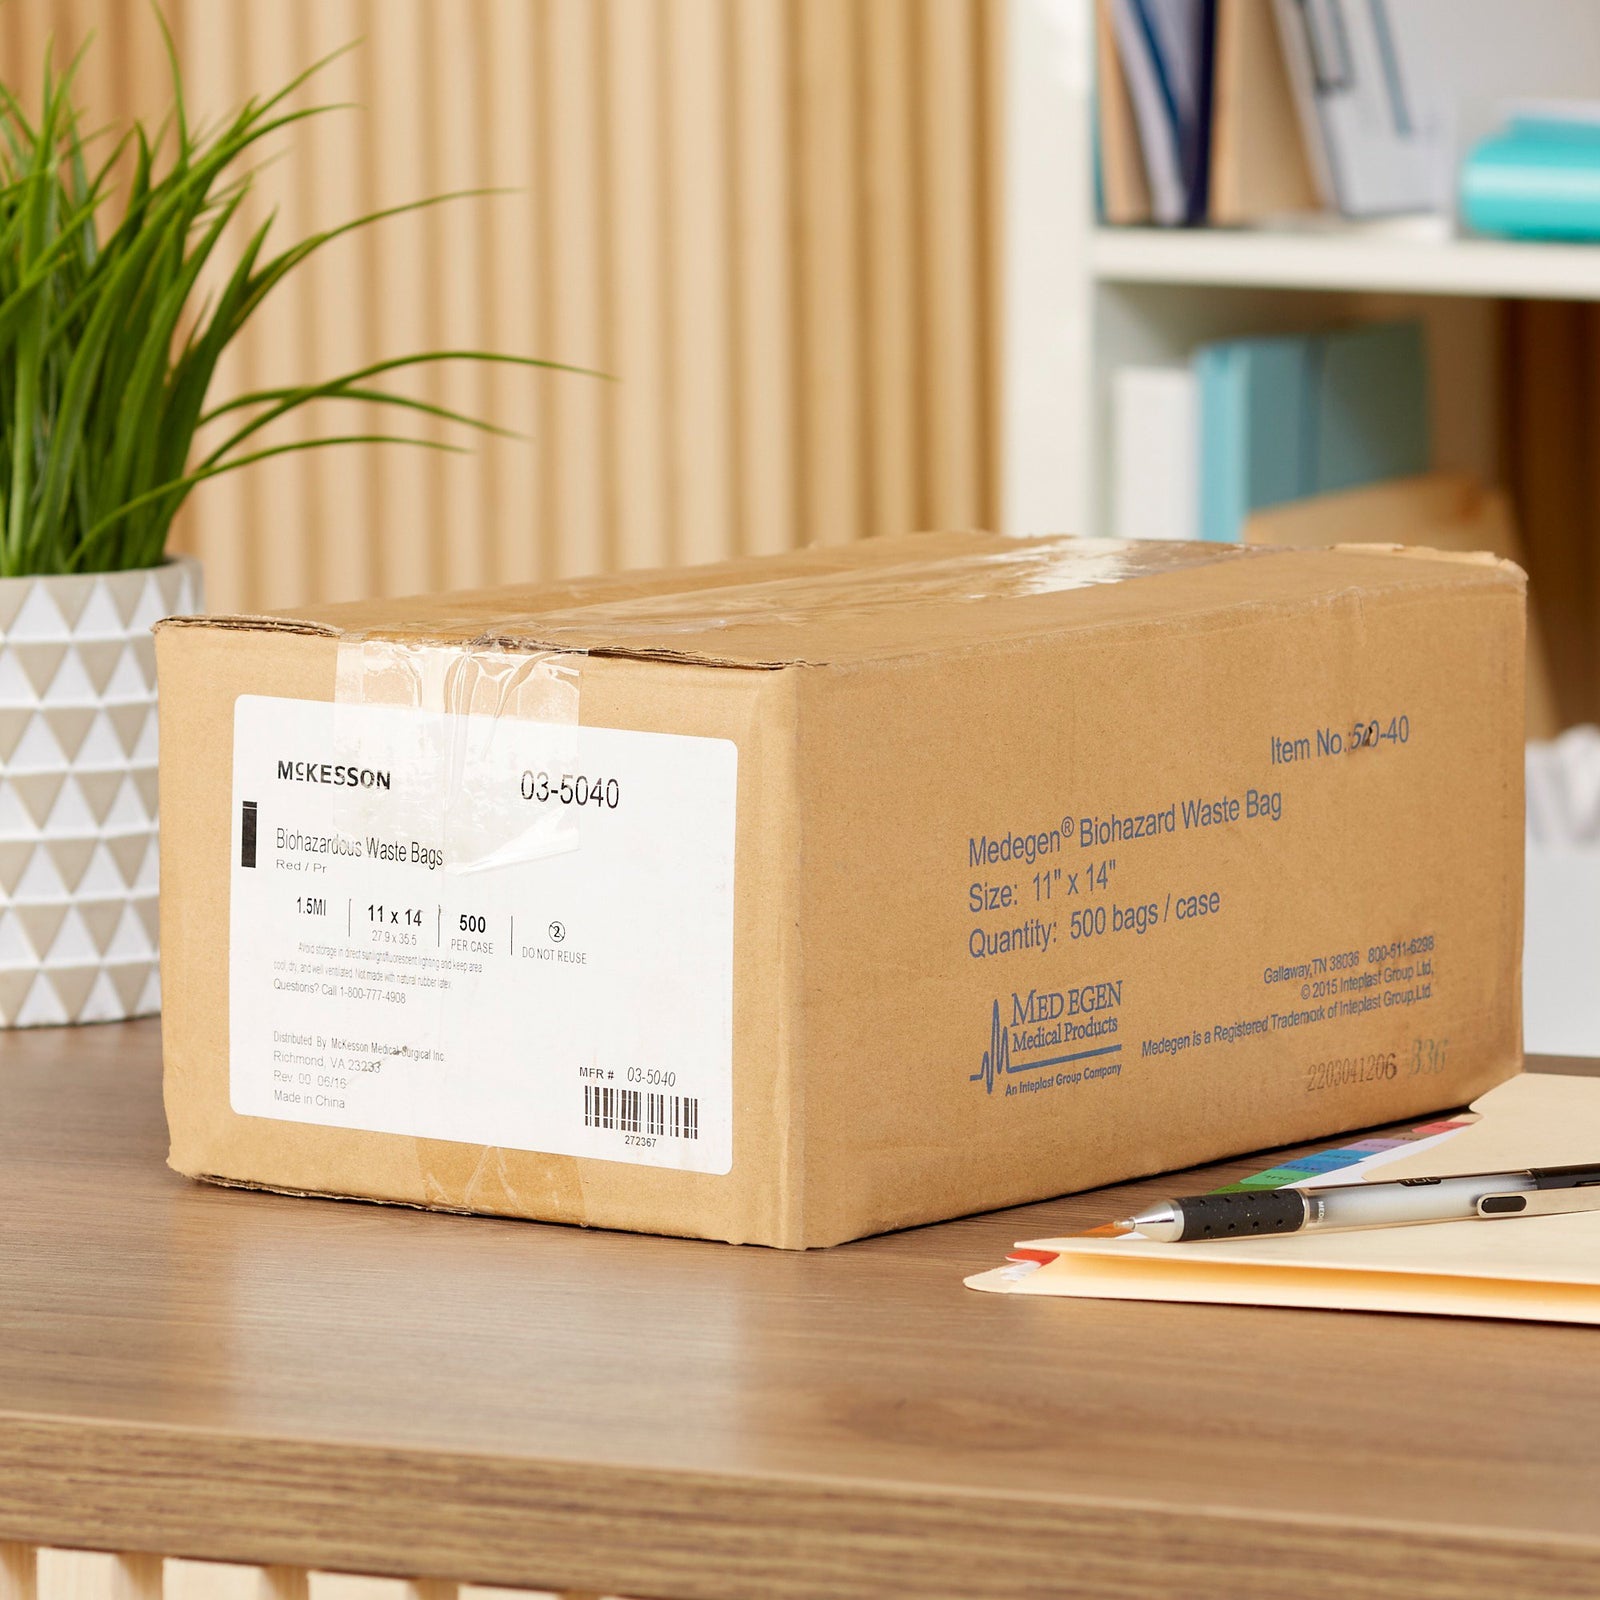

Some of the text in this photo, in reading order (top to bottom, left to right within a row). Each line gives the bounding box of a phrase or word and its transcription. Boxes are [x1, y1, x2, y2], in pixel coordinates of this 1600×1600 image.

[1271, 736, 1311, 765] Item
[521, 770, 619, 809] 03-5040
[1080, 804, 1176, 848] Biohazard
[1182, 795, 1240, 829] Waste
[1246, 789, 1283, 821] Bag
[276, 827, 443, 870] Biohazardous Waste Bags
[276, 859, 301, 871] Red
[968, 859, 1116, 913] Size: 11" x 14"
[367, 904, 422, 927] 11 x 14
[458, 914, 486, 934] 500
[968, 891, 1221, 959] Quantity: 500 bags / case
[451, 938, 494, 955] PER CASE
[522, 946, 587, 965] DO NOT REUSE
[1330, 950, 1360, 971] 38036
[273, 978, 406, 1004] Questions? Call 1-800-777-4908
[1312, 979, 1338, 999] 2015
[1340, 969, 1381, 995] Inteplast
[1384, 965, 1414, 984] Group
[1012, 1016, 1118, 1053] Medical Products
[1142, 1033, 1190, 1058] Medegen
[1192, 1030, 1202, 1046] is
[1204, 1032, 1212, 1045] a
[1213, 1015, 1269, 1045] Registered
[1327, 1003, 1337, 1020] of
[1339, 994, 1381, 1017] Inteplast
[273, 1031, 312, 1047] Distributed
[316, 1036, 327, 1050] By
[331, 1038, 369, 1053] McKesson
[330, 1057, 345, 1069] VA
[579, 1066, 676, 1087] MFR # 03-5040
[1005, 1063, 1122, 1097] An Inteplast Group Company
[274, 1089, 346, 1109] Made in China
[624, 1135, 657, 1148] 272367
